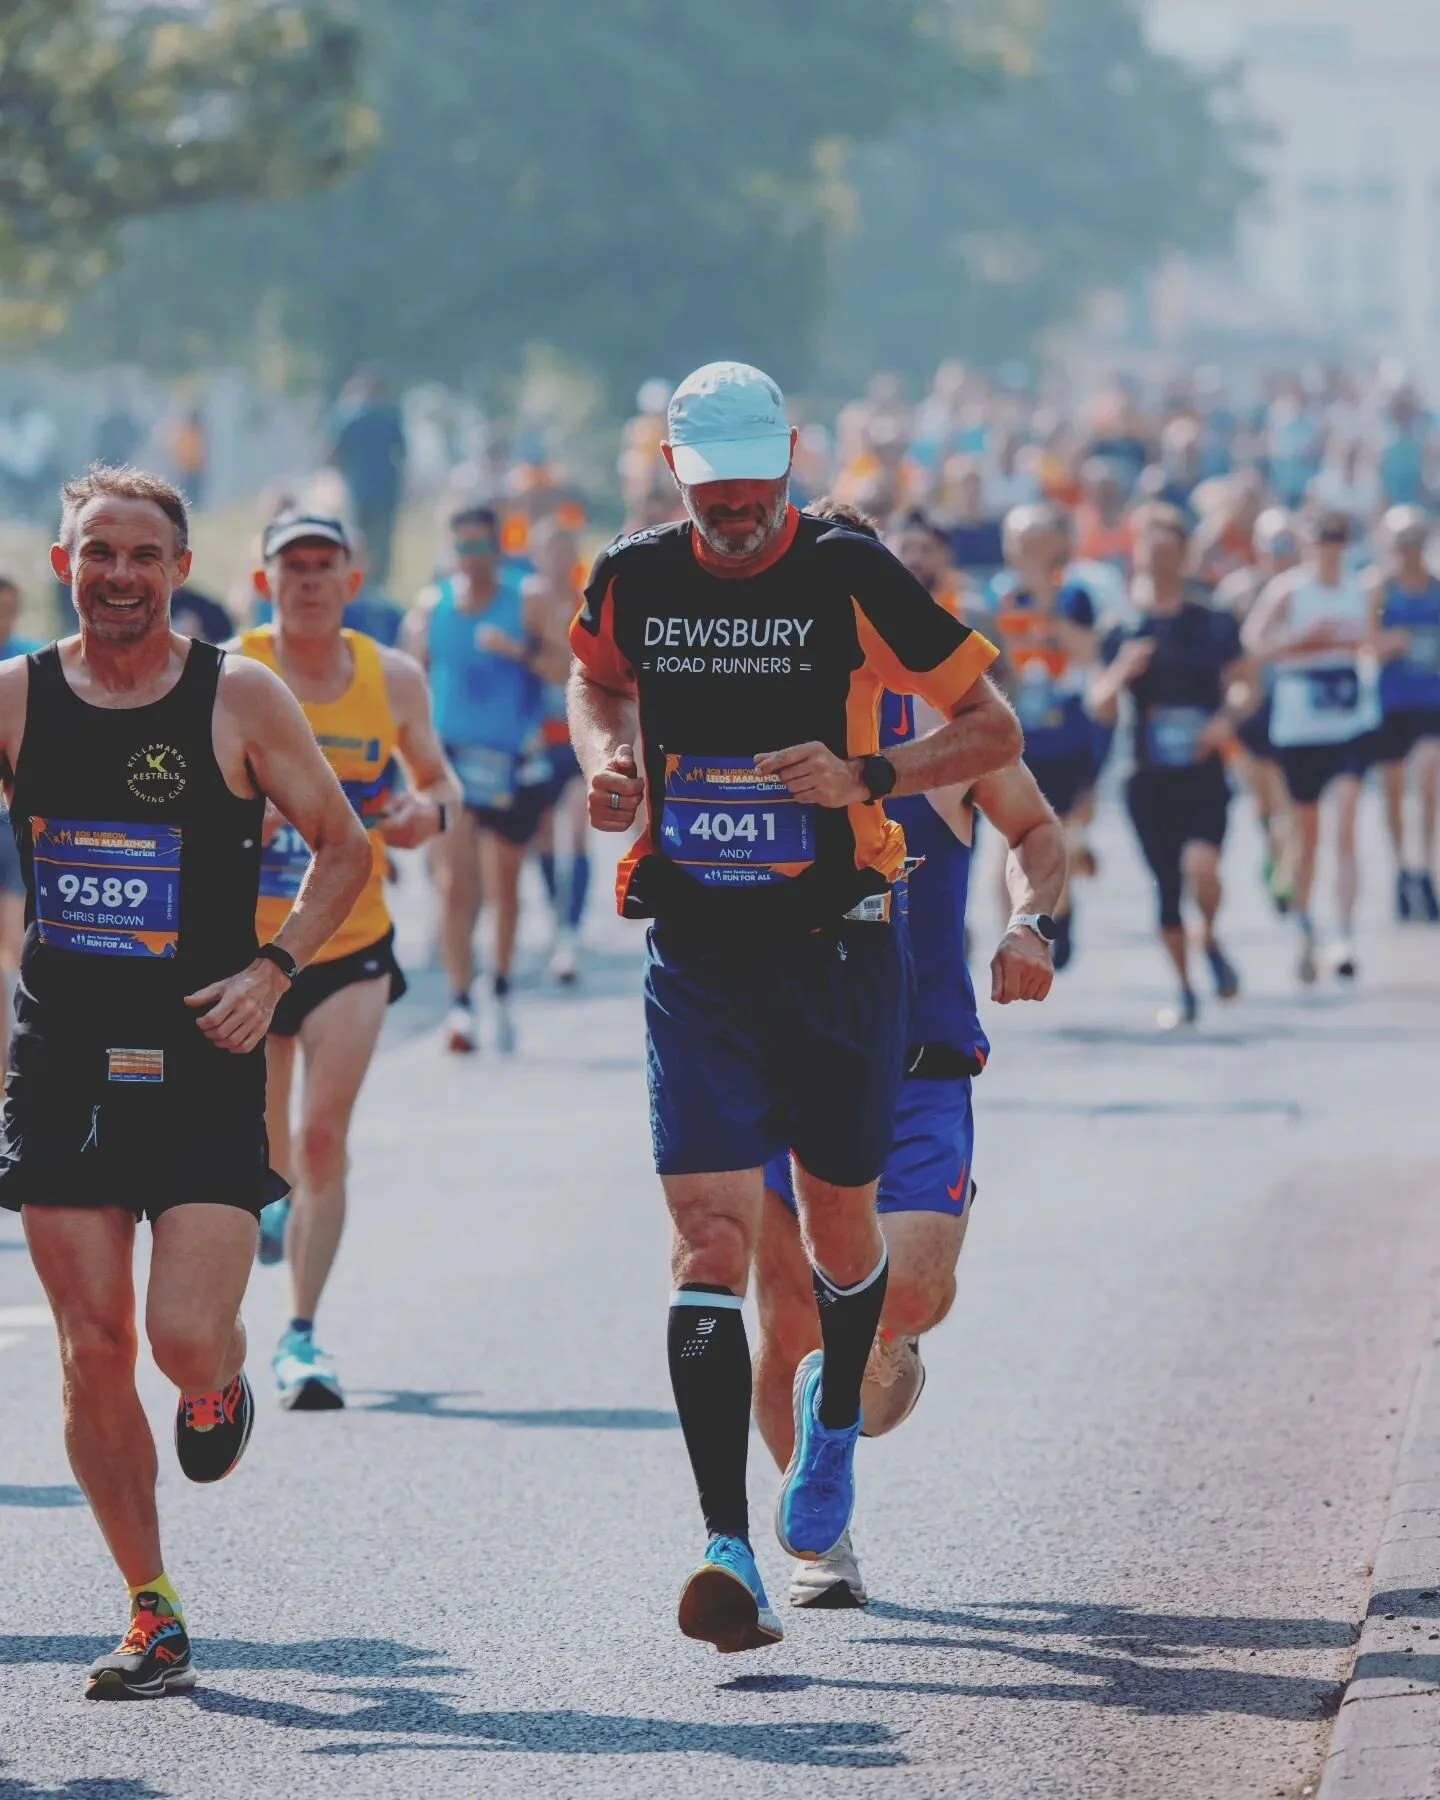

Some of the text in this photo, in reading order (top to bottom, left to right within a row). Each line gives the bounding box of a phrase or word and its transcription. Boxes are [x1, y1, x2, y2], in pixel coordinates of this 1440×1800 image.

[644, 616, 814, 648] DEWSBURY
[656, 656, 792, 675] ROAD RUNNERS
[127, 743, 187, 768] KILLAMARSH
[133, 772, 180, 781] KESTRELS
[706, 774, 782, 784] LEEDS MARAHO
[127, 778, 186, 803] RUNNING CLUB
[756, 782, 787, 791] Clarion
[665, 825, 675, 837] M
[689, 812, 775, 842] 4041
[74, 837, 157, 849] LEEDS MARATHON
[124, 848, 156, 857] Clarion
[719, 848, 752, 859] ANDY
[40, 885, 48, 897] M
[57, 874, 148, 908] 9589
[62, 909, 145, 926] CHRIS BROWN
[86, 939, 134, 950] RUN FOR ALL
